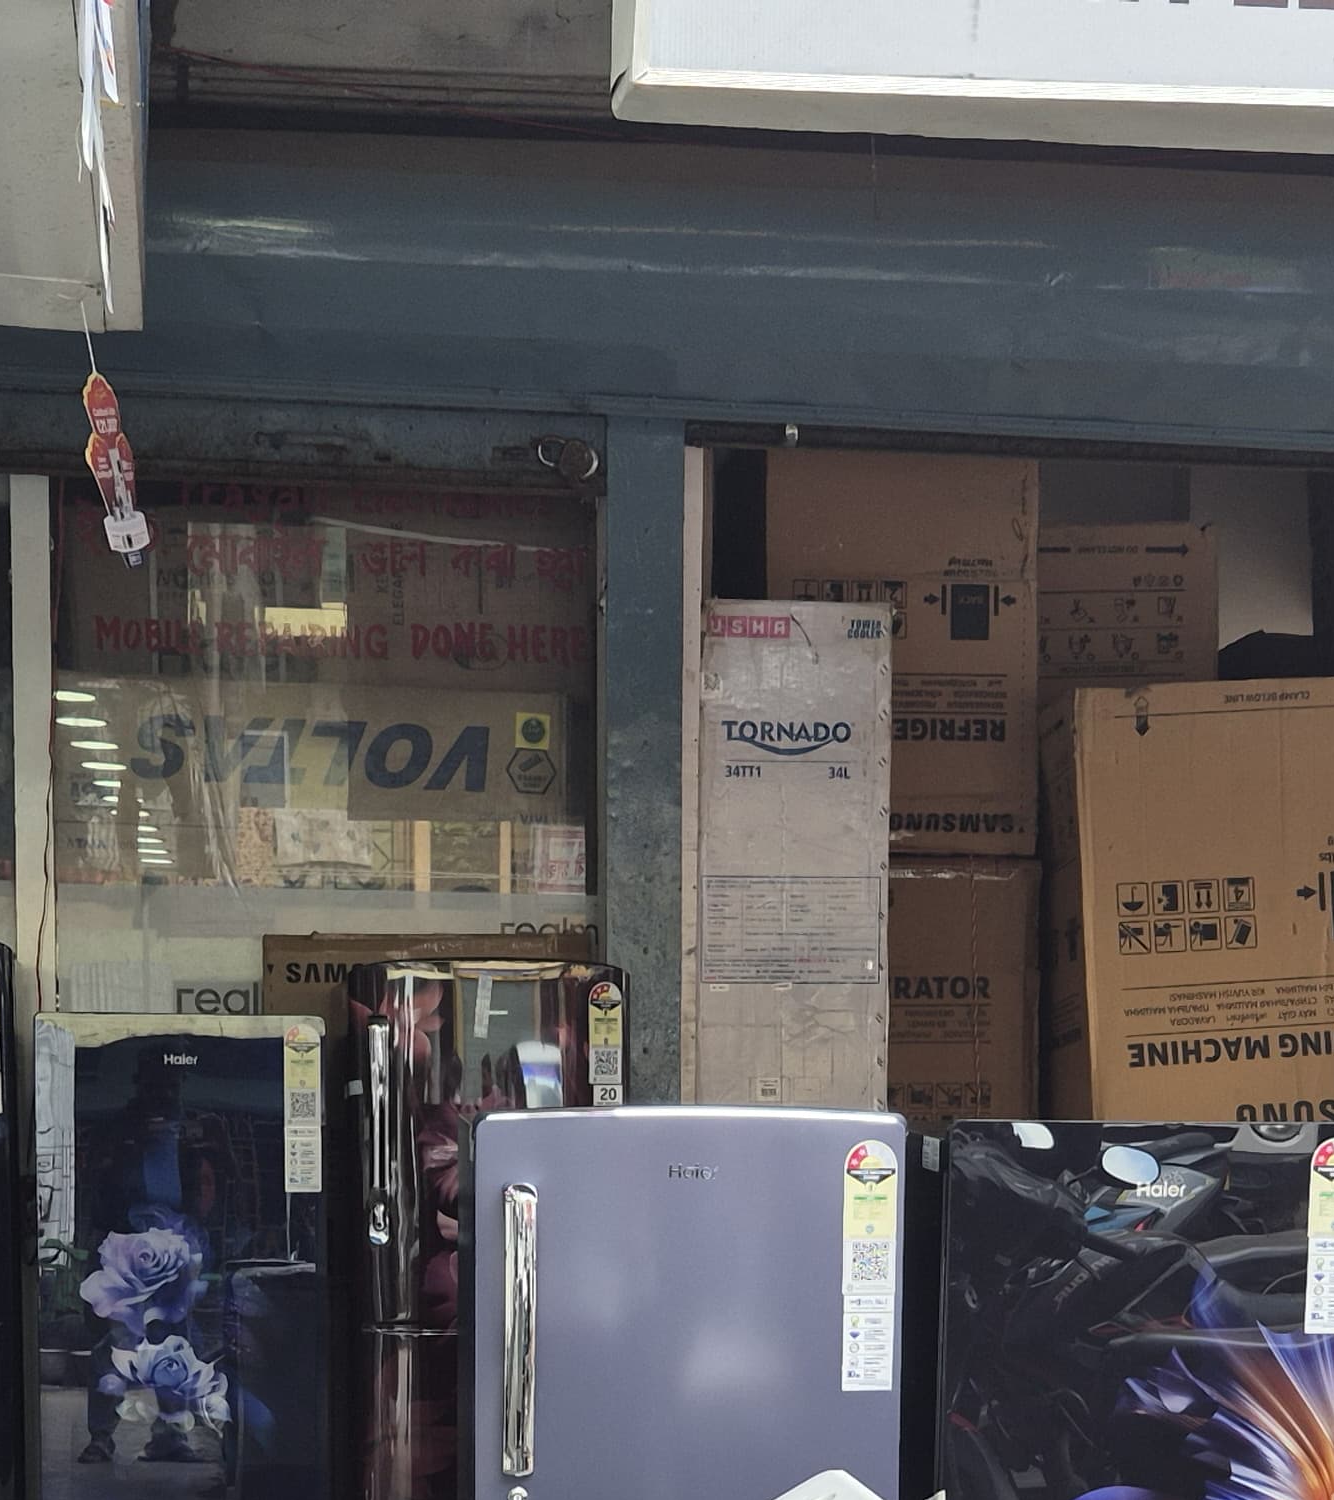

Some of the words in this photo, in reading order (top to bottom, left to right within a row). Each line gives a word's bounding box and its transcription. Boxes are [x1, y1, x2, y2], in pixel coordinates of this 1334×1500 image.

[709, 618, 788, 638] USHA
[411, 621, 496, 662] DONE
[506, 622, 591, 665] HERE
[721, 720, 852, 743] TORNADO
[725, 765, 761, 778] 34TT1
[828, 766, 851, 779] 34L
[163, 1053, 199, 1067] Haier
[1126, 1035, 1270, 1068] MACHINE
[600, 1087, 617, 1101] 20
[667, 1162, 719, 1182] Haier
[1135, 1180, 1187, 1199] Haier
